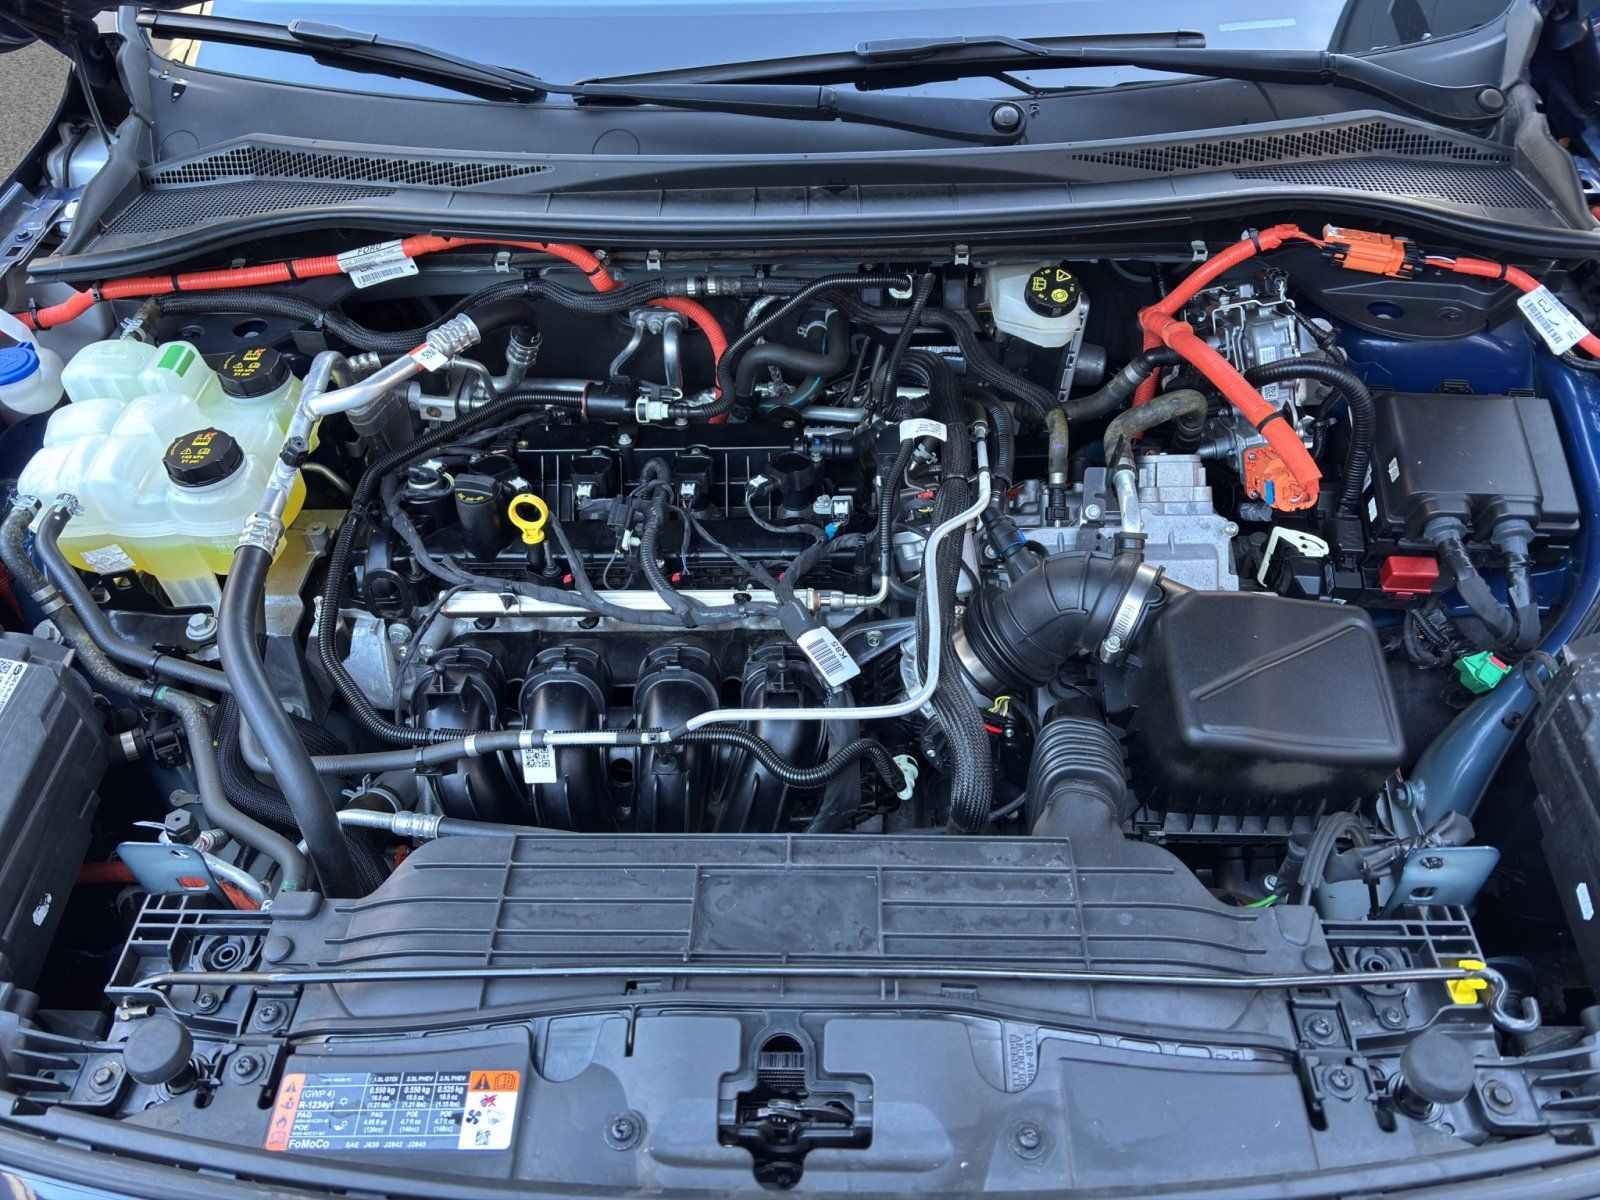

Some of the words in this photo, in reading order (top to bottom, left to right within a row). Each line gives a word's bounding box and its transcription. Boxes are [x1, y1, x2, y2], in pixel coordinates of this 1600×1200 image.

[1537, 298, 1552, 313] CJ
[830, 641, 848, 660] K85
[301, 1090, 326, 1099] (GWP
[326, 1090, 336, 1099] 4)
[386, 1087, 396, 1095] kg
[421, 1086, 430, 1094] kg
[455, 1086, 464, 1094] kg
[298, 1101, 334, 1110] R-1234yf
[288, 1139, 330, 1148] FoMoCo
